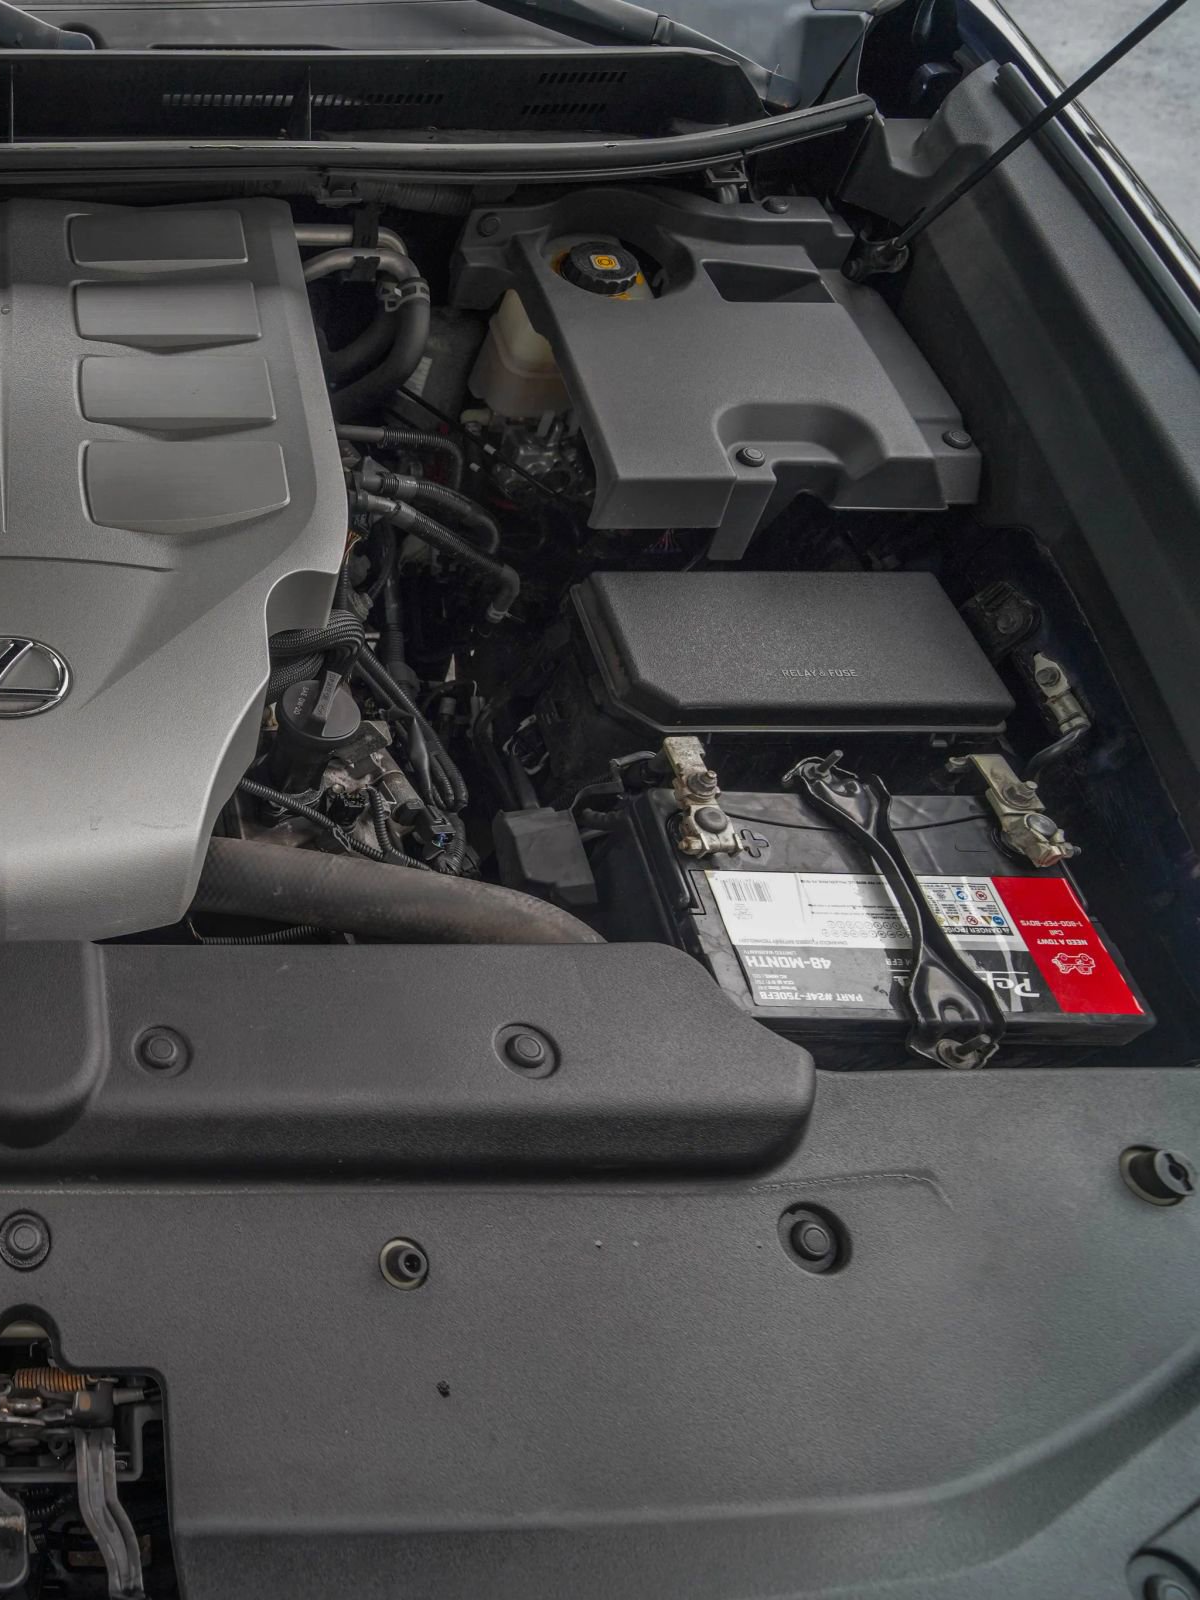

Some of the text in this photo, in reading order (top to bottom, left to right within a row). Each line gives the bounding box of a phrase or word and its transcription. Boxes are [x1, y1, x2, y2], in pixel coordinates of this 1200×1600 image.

[782, 669, 817, 677] RELAY
[828, 669, 858, 677] FUSE
[745, 956, 832, 969] 48-MONTH
[836, 993, 864, 1002] PART
